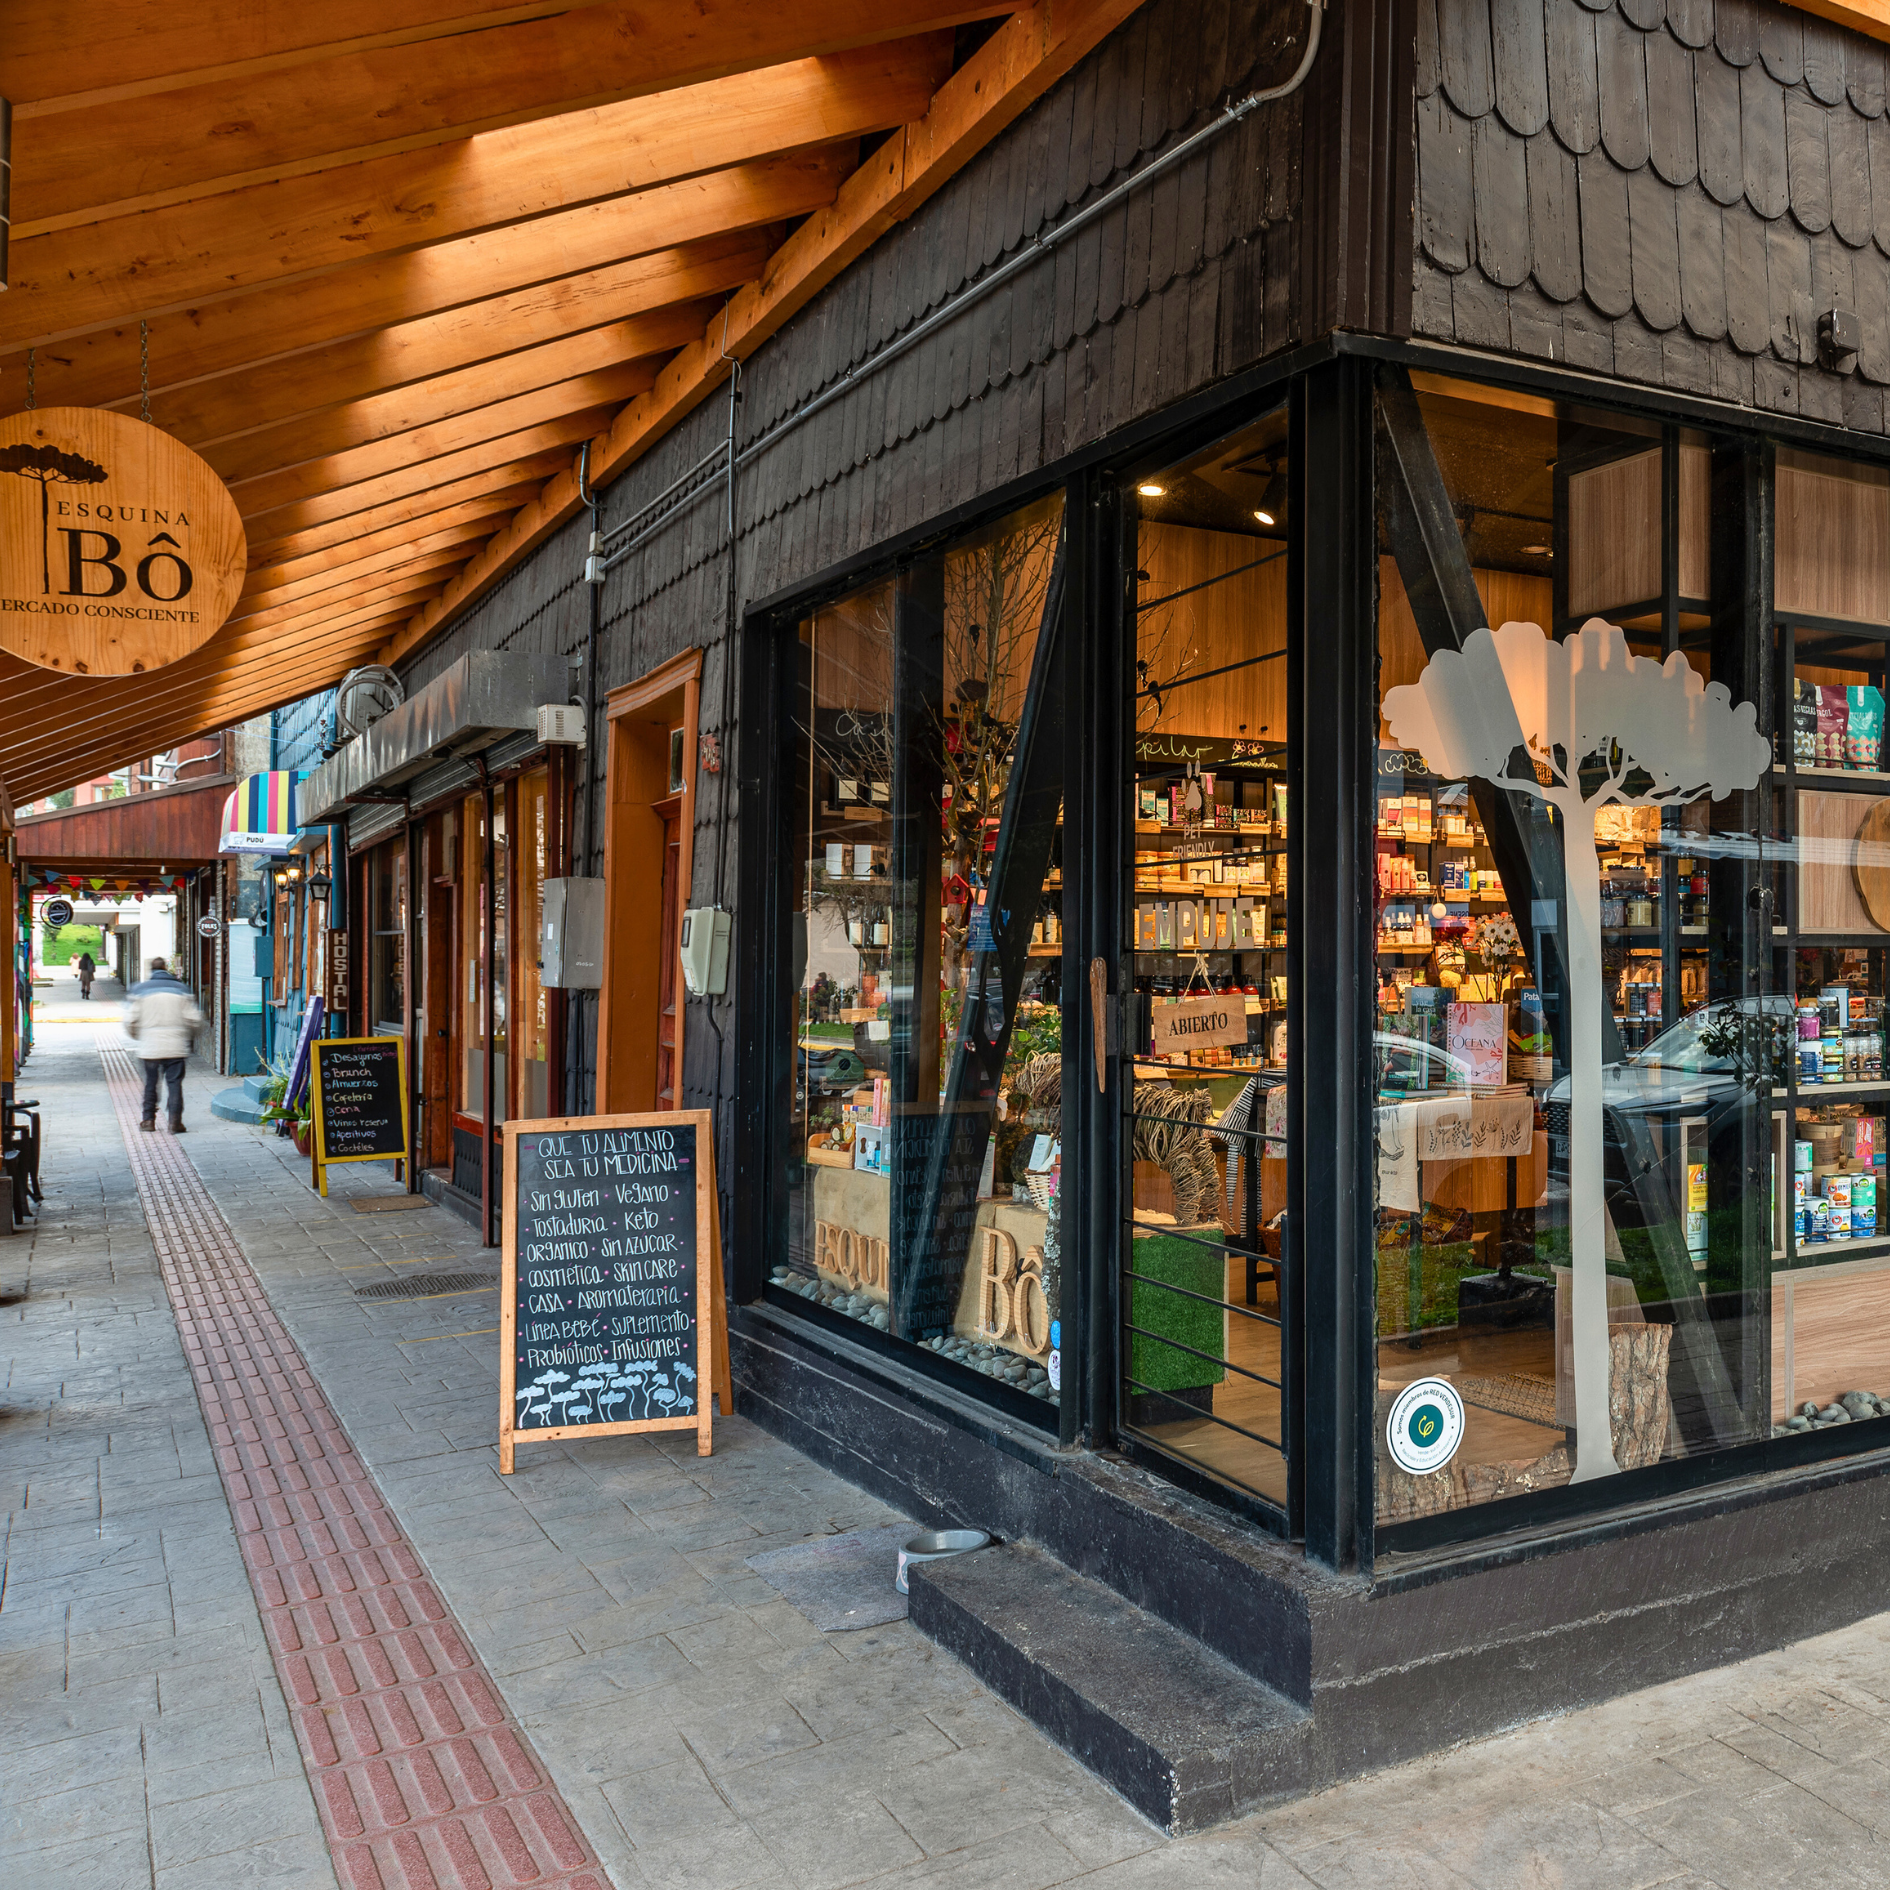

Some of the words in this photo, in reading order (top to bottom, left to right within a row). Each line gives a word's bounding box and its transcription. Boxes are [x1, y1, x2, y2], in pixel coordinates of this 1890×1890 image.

[56, 500, 190, 526] ESQUINA
[56, 527, 193, 602] Bô
[0, 598, 80, 616] ERCADO
[84, 603, 200, 623] CONSCIENTE
[1184, 822, 1201, 840] PET
[1172, 841, 1215, 861] FRIENDLY
[1139, 897, 1254, 950] EMPUJE
[333, 932, 347, 1010] HOSTAL
[1169, 1011, 1228, 1036] ABIERTO
[1452, 1035, 1497, 1049] OCEANA
[330, 1053, 382, 1067] Desayunos
[331, 1068, 372, 1078] Brunch
[332, 1079, 378, 1089] Almuerzos
[334, 1106, 361, 1114] Cena
[333, 1119, 357, 1127] Vinos
[336, 1130, 377, 1141] Aperitivos
[538, 1135, 573, 1158] QUE
[578, 1133, 599, 1155] TU
[544, 1159, 575, 1180] SEA
[578, 1156, 599, 1177] TU
[530, 1190, 550, 1212] Sin
[974, 1225, 1050, 1355] Bô
[1402, 1392, 1422, 1413] miembros
[1429, 1389, 1440, 1397] RED
[1439, 1392, 1456, 1419] VERDESUR
